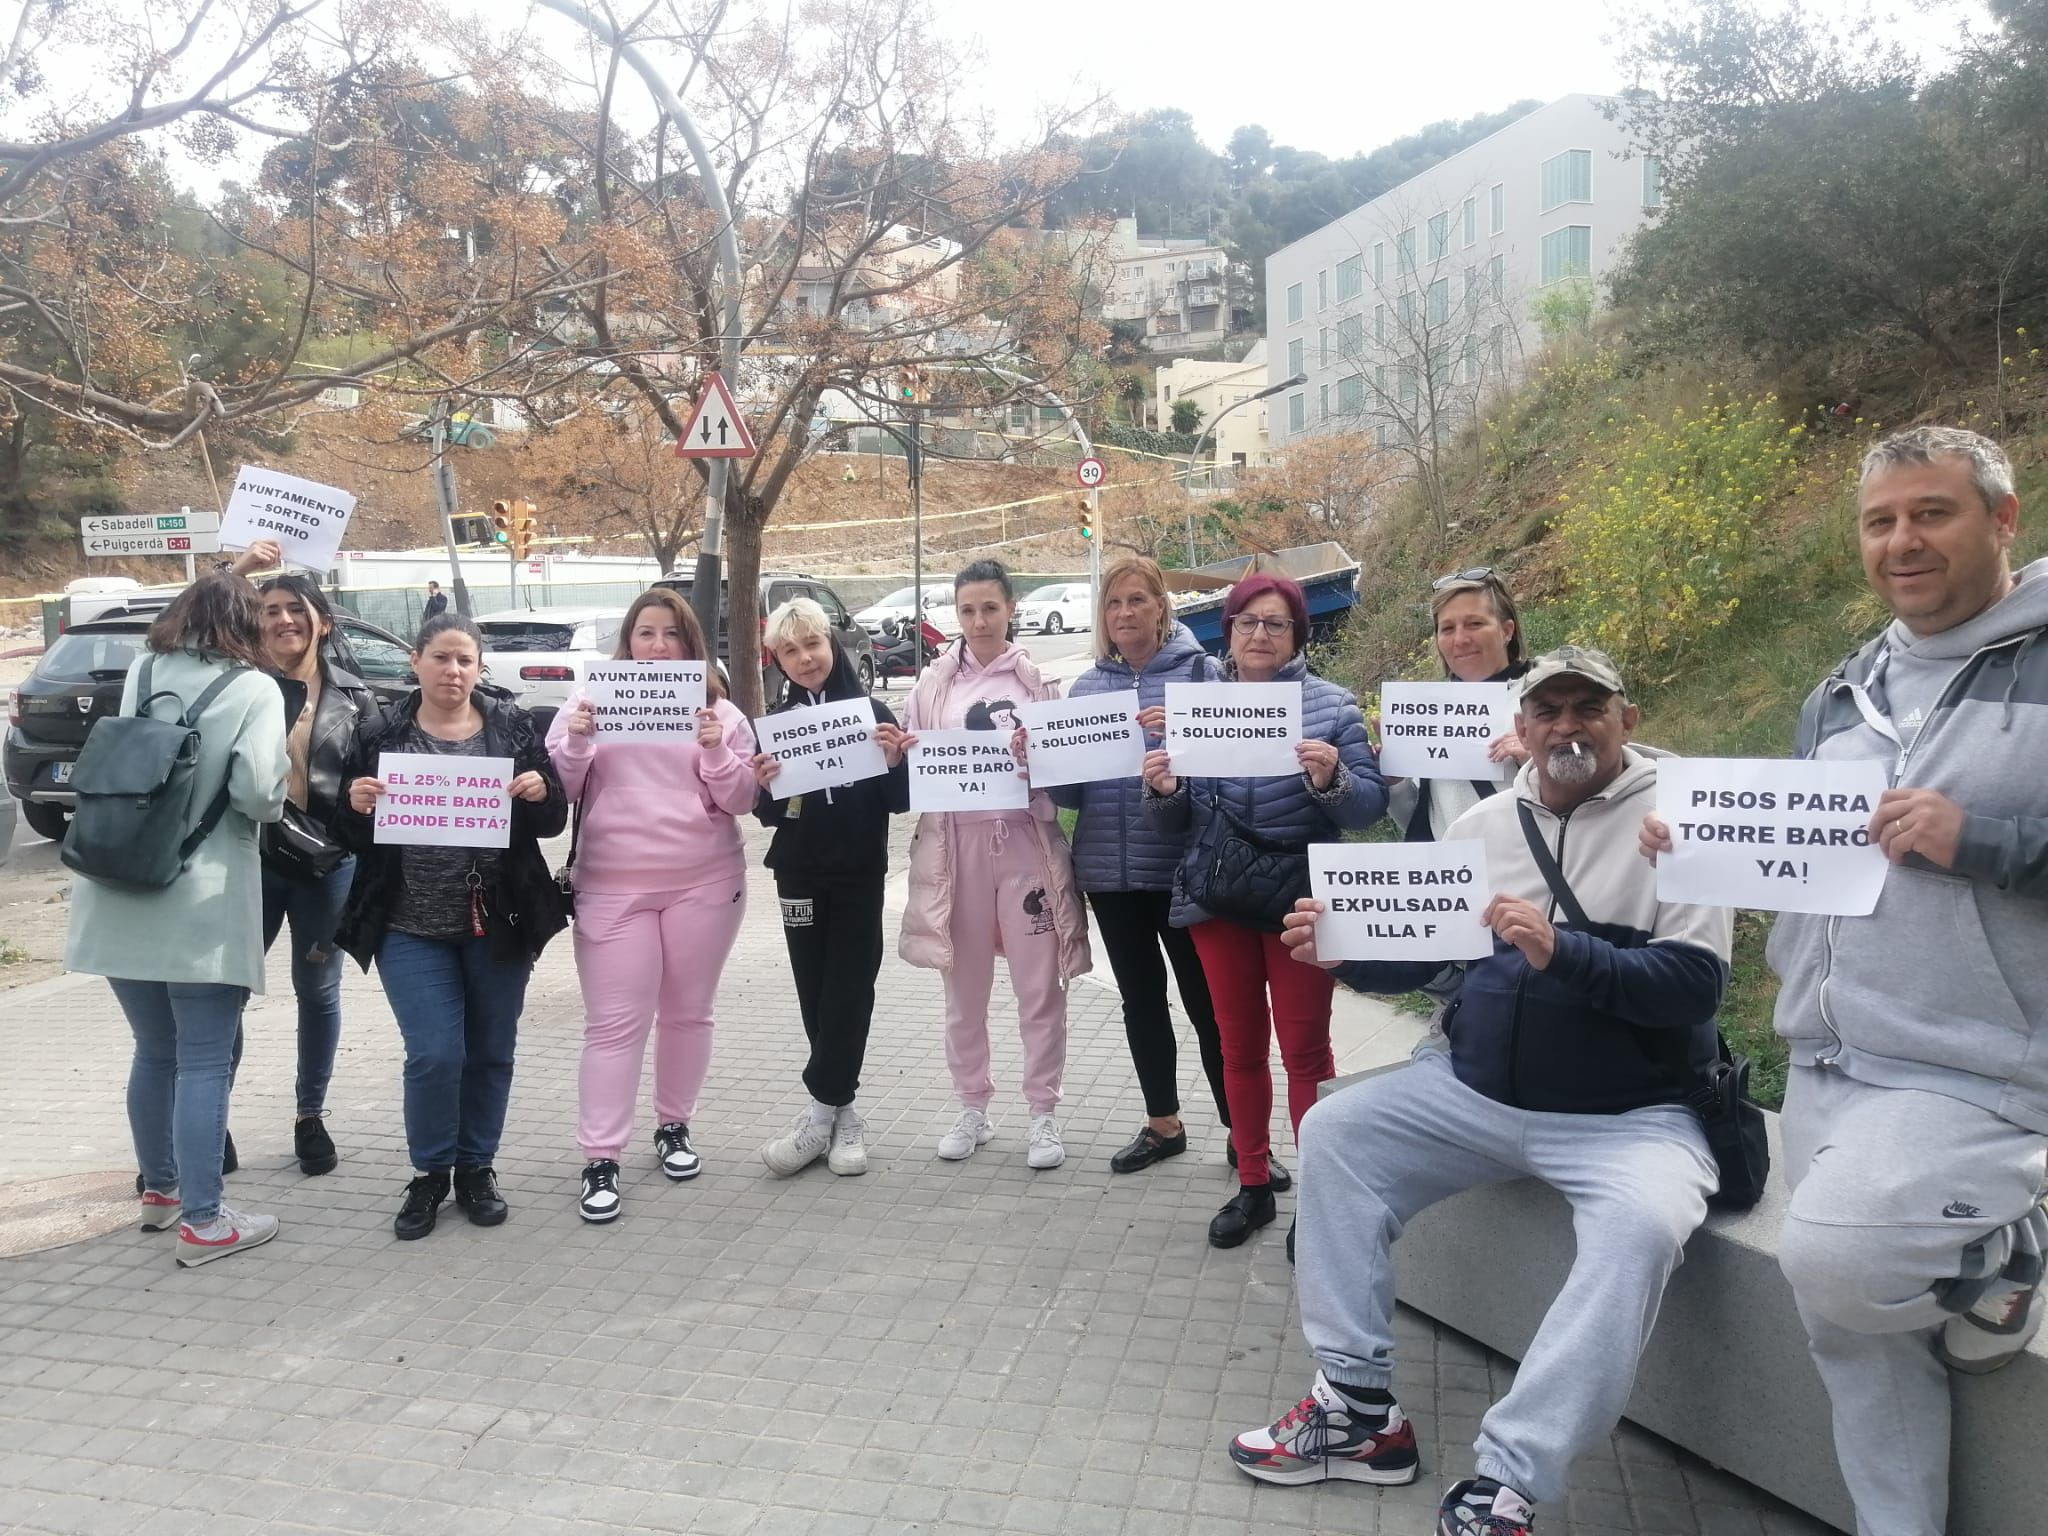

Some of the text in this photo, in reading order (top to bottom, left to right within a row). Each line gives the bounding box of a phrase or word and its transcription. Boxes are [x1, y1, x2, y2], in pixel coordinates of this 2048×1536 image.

[1083, 467, 1099, 478] 30
[238, 482, 345, 519] AYUNTAMIENTO
[265, 503, 320, 527] SORTEO
[101, 518, 184, 530] Sabadell N-150
[258, 518, 309, 540] BARRIO
[169, 540, 189, 549] C-17
[588, 672, 702, 682] AYUNTAMIENTO
[615, 689, 676, 699] NO DEJA
[1192, 707, 1287, 718] REUNIONES
[1391, 703, 1490, 716] PISOS PARA
[596, 720, 693, 732] LOS JÓVENES
[772, 714, 863, 743] PISOS PARA
[1047, 712, 1127, 731] REUNIONES
[1182, 727, 1287, 738] SOLUCIONES
[1385, 723, 1491, 738] TORRE BARÓ
[771, 730, 867, 762] TORRE BARÓ
[1042, 729, 1130, 749] SOLUCIONES
[922, 745, 1010, 757] PISOS PARA
[1427, 747, 1449, 759] YA
[816, 756, 844, 770] YA!
[917, 760, 1014, 775] TORRE BARÓ
[388, 773, 503, 789] EL 25% PARA
[959, 782, 986, 795] YA!
[388, 793, 501, 809] TORRE BARÓ
[1691, 790, 1871, 813] PISOS PARA
[377, 814, 508, 830] ¿DONDE ESTÁ?
[1679, 823, 1869, 847] TORRE BARÓ
[1323, 865, 1473, 886] TORRE BARÓ
[1756, 859, 1809, 884] YA!
[795, 904, 813, 917] FUN
[1331, 897, 1470, 912] EXPULSADA
[1367, 924, 1437, 938] ILLA F
[1950, 1200, 1981, 1215] NIKE
